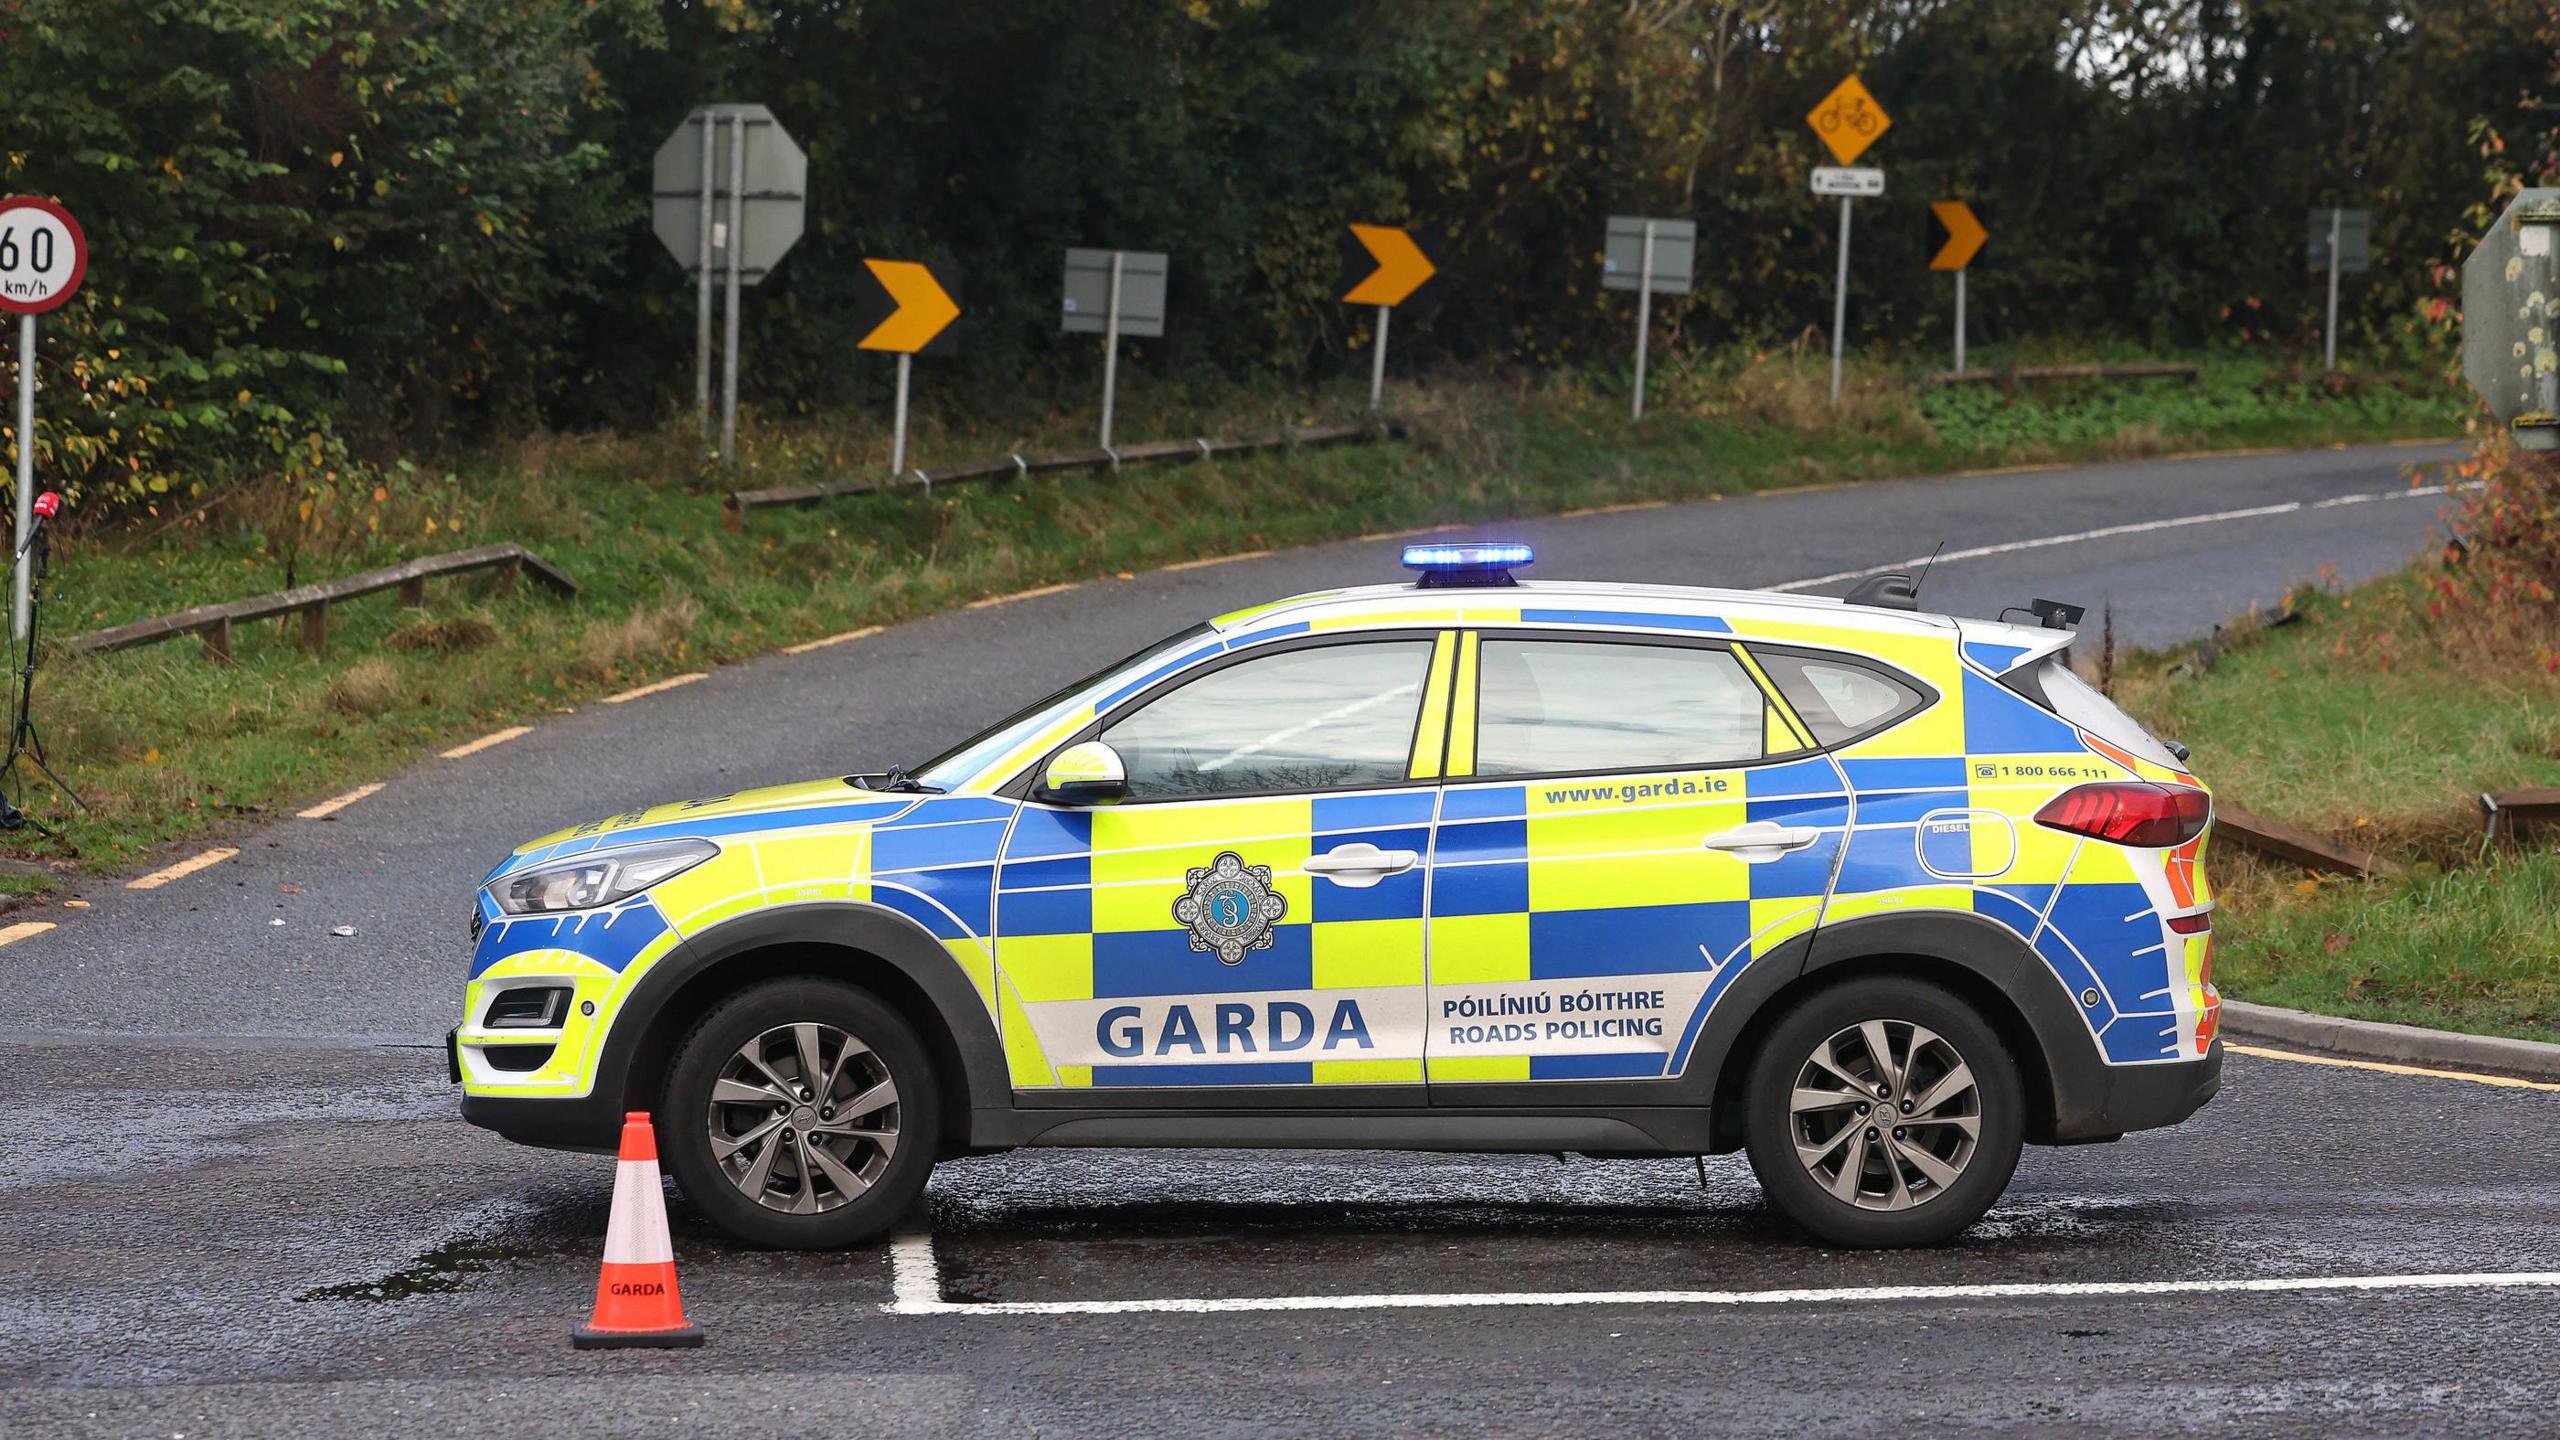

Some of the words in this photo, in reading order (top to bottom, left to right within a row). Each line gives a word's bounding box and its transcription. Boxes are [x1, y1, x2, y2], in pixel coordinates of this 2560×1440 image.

[0, 226, 53, 273] 60
[5, 279, 48, 298] km/h
[2002, 766, 2010, 776] 1
[2015, 765, 2044, 776] 800
[2048, 766, 2077, 777] 666
[2082, 768, 2108, 779] 111
[1545, 776, 1728, 804] www.garda.ie
[1932, 822, 1970, 834] DIESEL
[1443, 991, 1551, 1019] PÓILÍNIÚ
[1560, 989, 1665, 1013] BÓITHRE
[1096, 999, 1375, 1058] GARDA
[1450, 1022, 1537, 1045] ROADS
[1545, 1017, 1663, 1040] POLICING
[610, 1283, 665, 1296] GARDA
